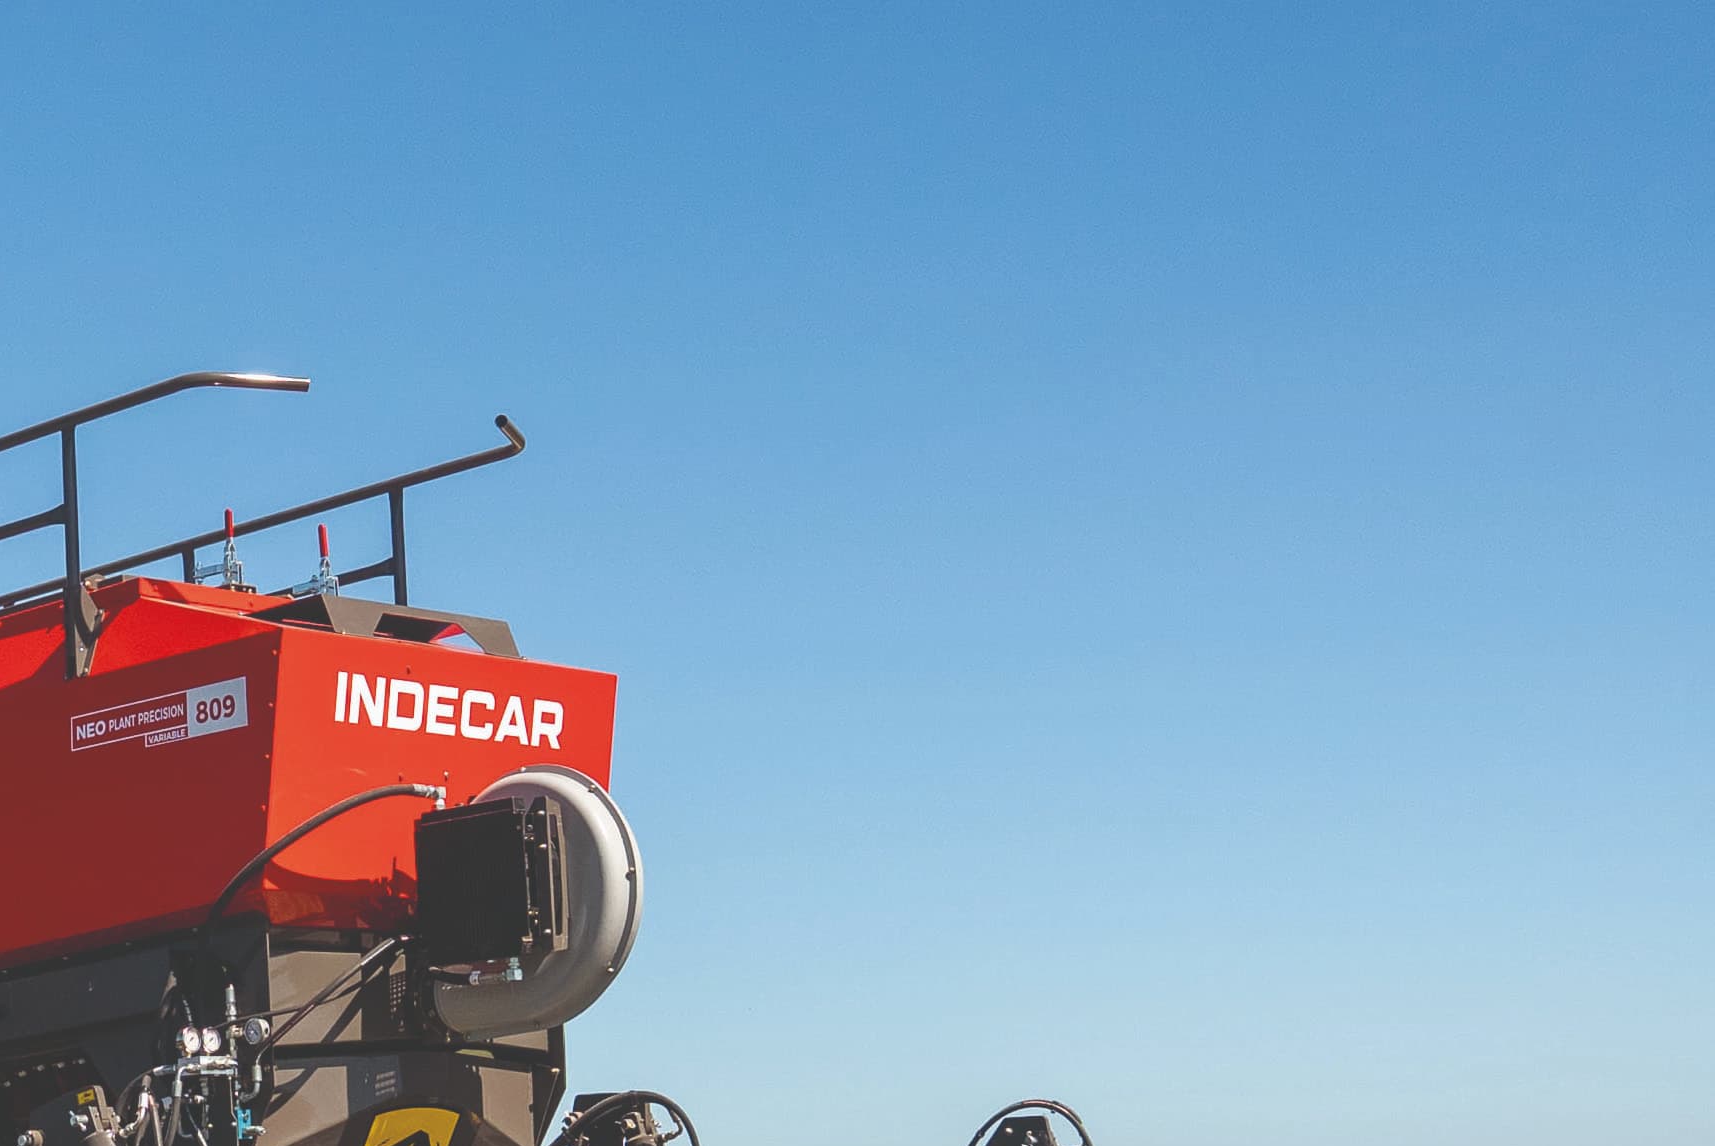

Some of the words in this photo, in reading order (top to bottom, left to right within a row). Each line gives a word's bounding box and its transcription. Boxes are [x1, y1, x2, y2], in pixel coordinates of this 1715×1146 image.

[76, 720, 107, 741] NEO
[108, 714, 137, 732] PLANT
[138, 703, 185, 725] PRECISION
[195, 694, 236, 724] 809
[334, 671, 564, 750] INDECAR
[148, 728, 186, 744] VARIABLE
